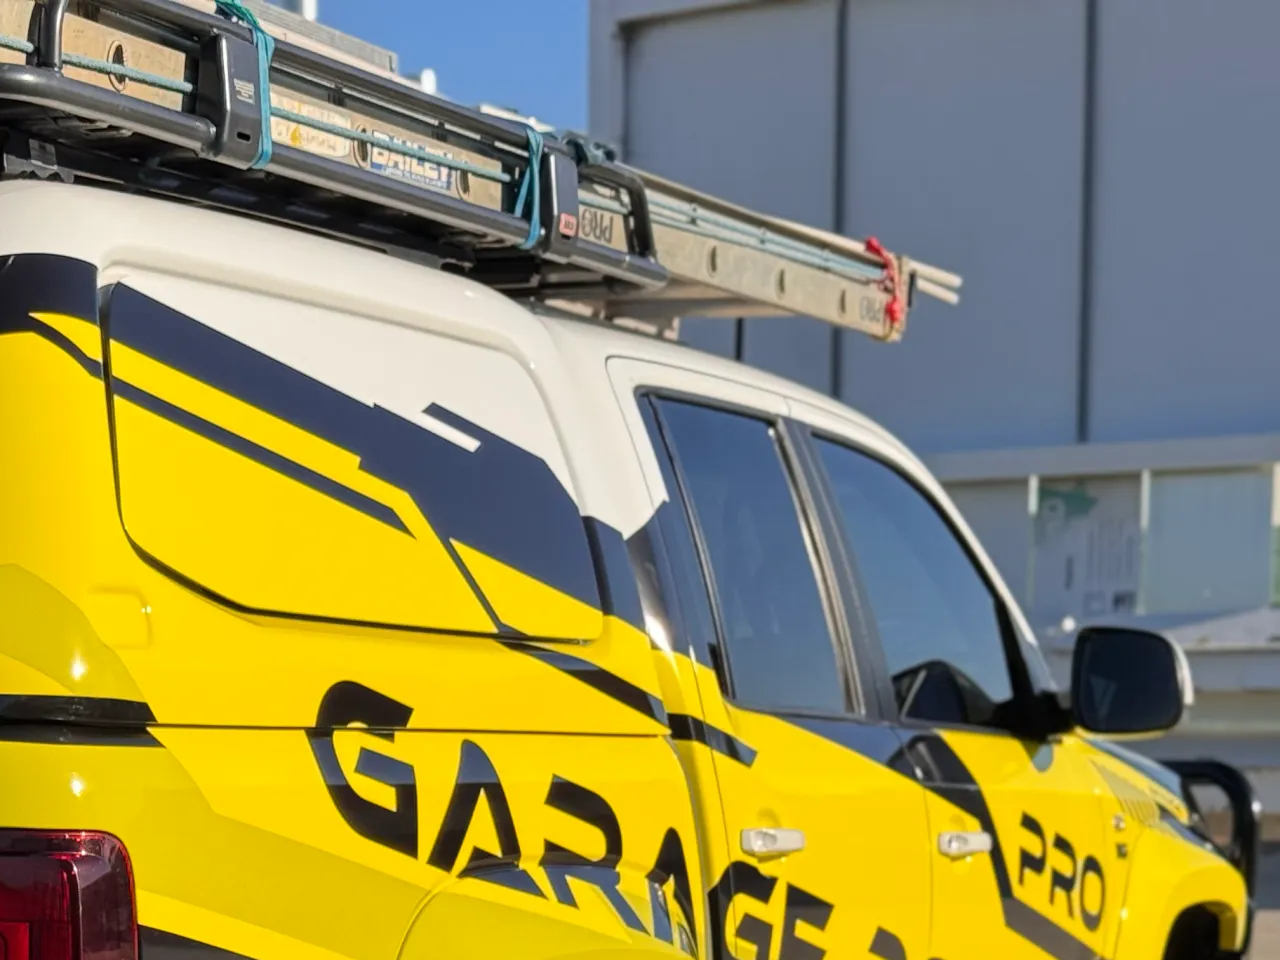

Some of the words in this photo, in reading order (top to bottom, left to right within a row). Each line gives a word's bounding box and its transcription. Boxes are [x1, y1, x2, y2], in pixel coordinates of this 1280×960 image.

[372, 129, 453, 184] BAILEY
[581, 207, 614, 244] PRO
[1018, 811, 1106, 933] PRO
